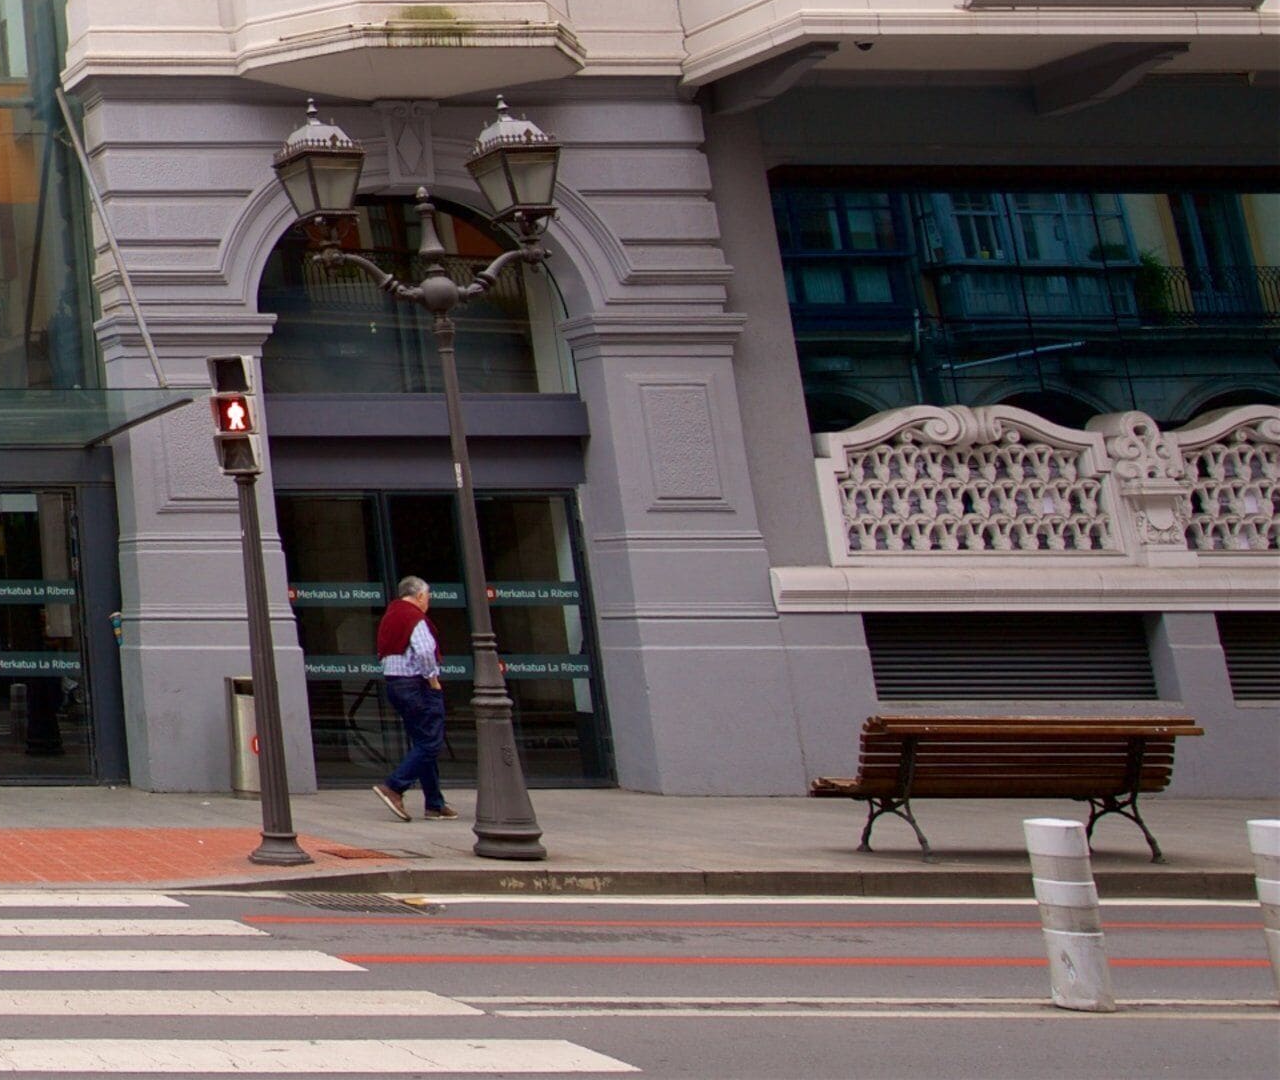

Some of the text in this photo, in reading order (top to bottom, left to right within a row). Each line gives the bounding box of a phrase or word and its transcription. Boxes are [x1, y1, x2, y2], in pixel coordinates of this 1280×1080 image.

[34, 586, 45, 596] La
[47, 586, 75, 596] Ribera
[297, 589, 337, 599] Merkatua
[340, 589, 350, 599] La
[352, 589, 381, 599] Ribera
[429, 589, 458, 599] rkatua
[495, 589, 536, 598] Merkatua
[538, 589, 549, 598] La
[551, 589, 580, 598] Ribera
[39, 659, 50, 669] La
[52, 659, 81, 669] Ribera
[305, 663, 345, 673] Merkatua
[348, 663, 359, 673] La
[505, 663, 546, 672] Merkatua
[548, 663, 559, 672] La
[561, 663, 589, 672] Ribera
